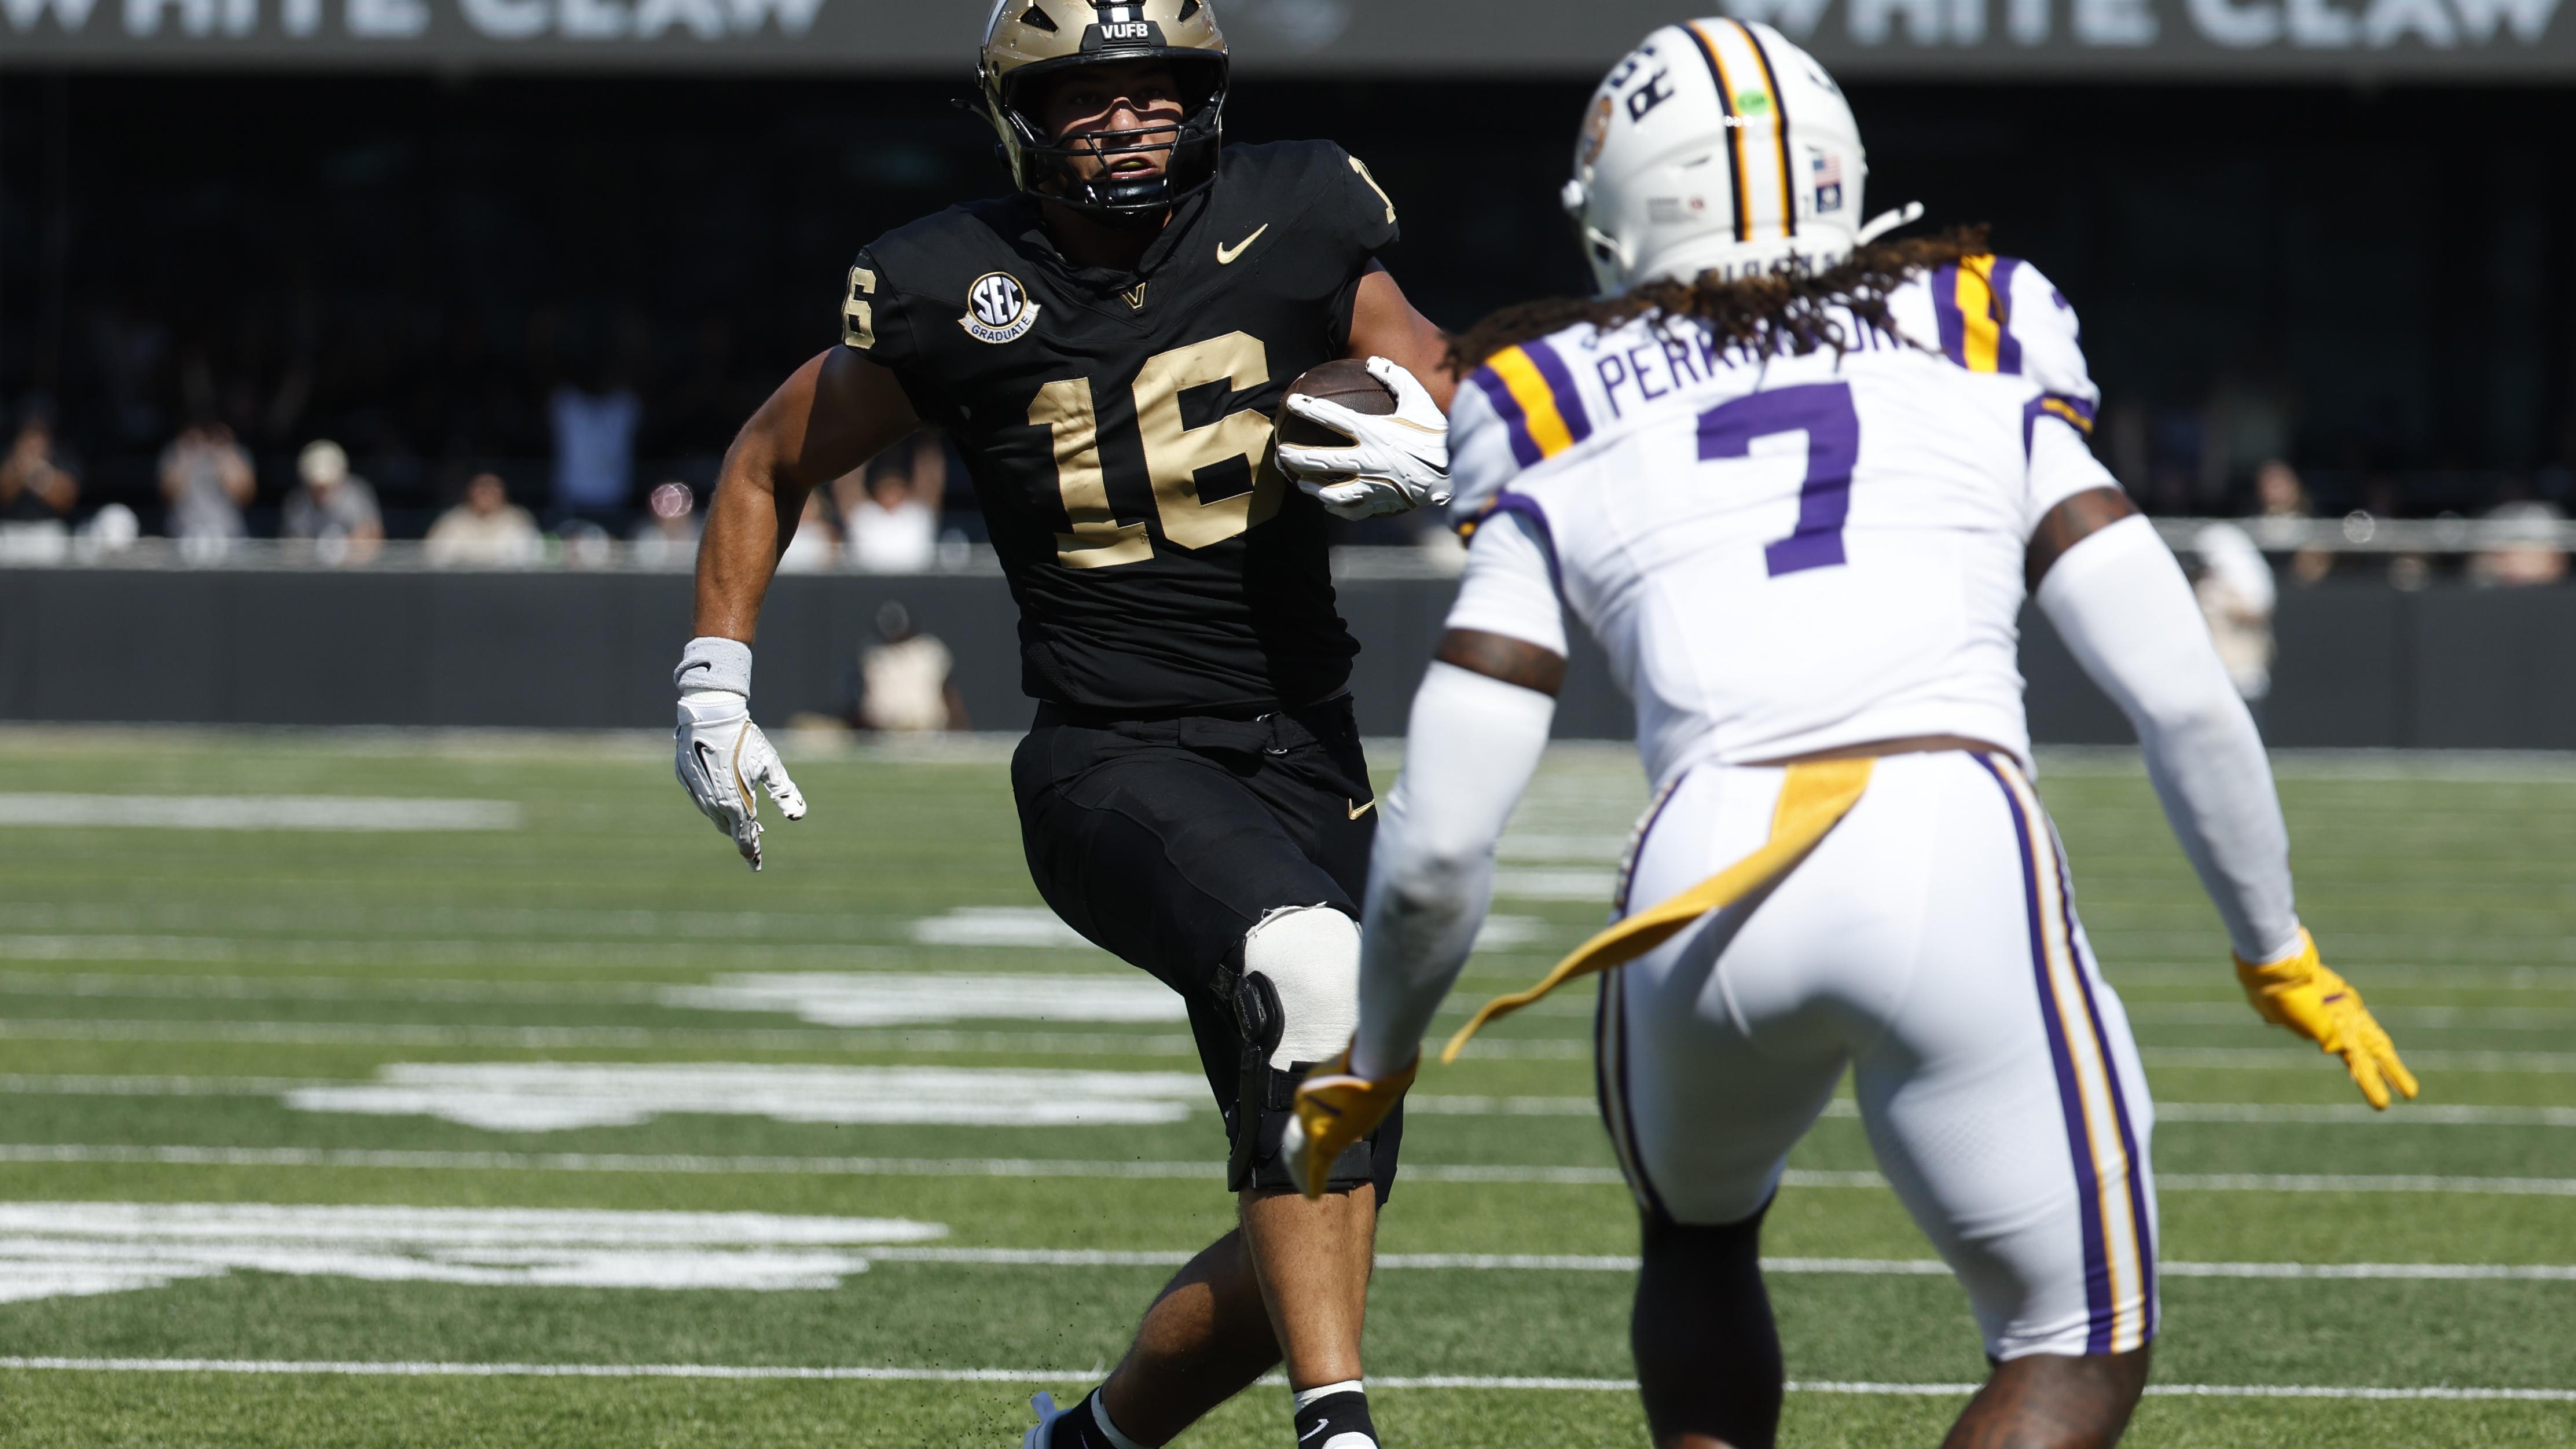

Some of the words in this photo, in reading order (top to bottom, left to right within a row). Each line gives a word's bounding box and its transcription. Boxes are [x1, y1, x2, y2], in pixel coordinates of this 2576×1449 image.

[1101, 23, 1148, 41] VUFB
[842, 267, 876, 350] 6
[971, 316, 1032, 342] GRADUATE
[973, 276, 1022, 325] SEC
[1027, 330, 1286, 569] 16
[1697, 381, 1860, 578] 7
